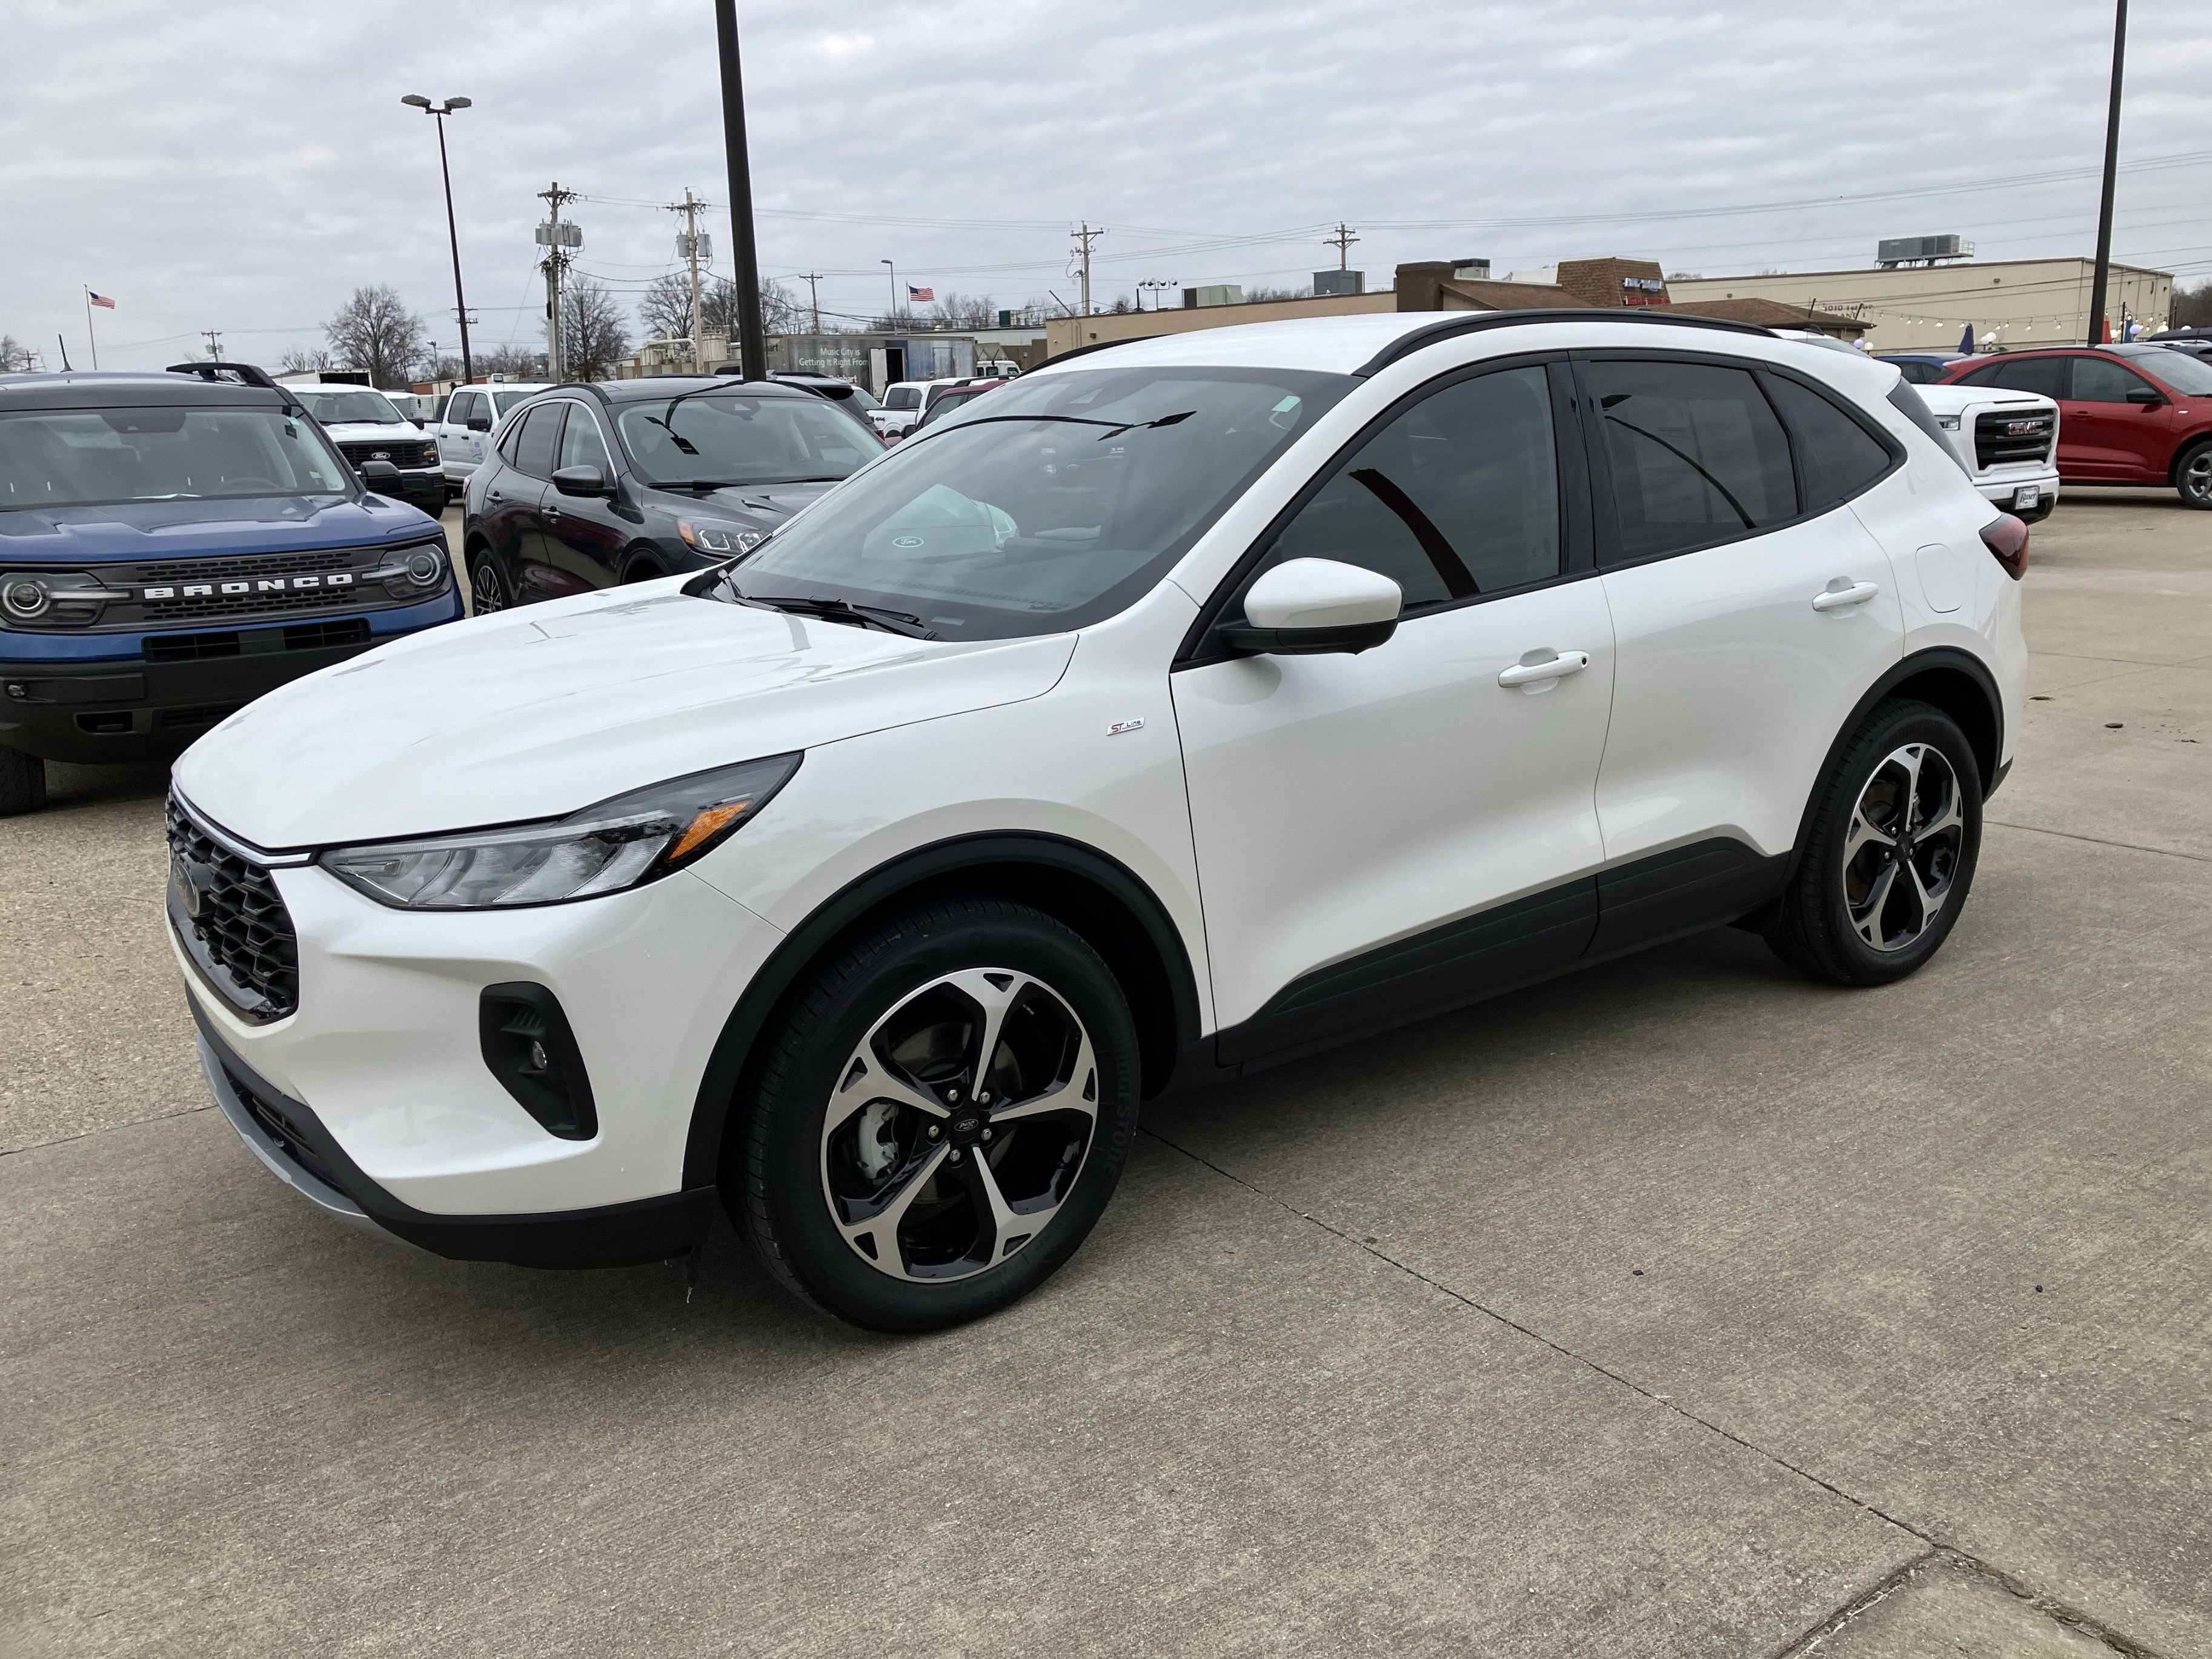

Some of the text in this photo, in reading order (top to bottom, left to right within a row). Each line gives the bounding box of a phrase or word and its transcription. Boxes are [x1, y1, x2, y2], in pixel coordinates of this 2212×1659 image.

[820, 348, 840, 356] Music
[841, 348, 854, 357] City
[799, 358, 825, 368] Getting
[833, 358, 851, 368] Right
[2008, 421, 2043, 435] GMC
[144, 573, 353, 599] BRONCO
[1111, 722, 1124, 733] ST
